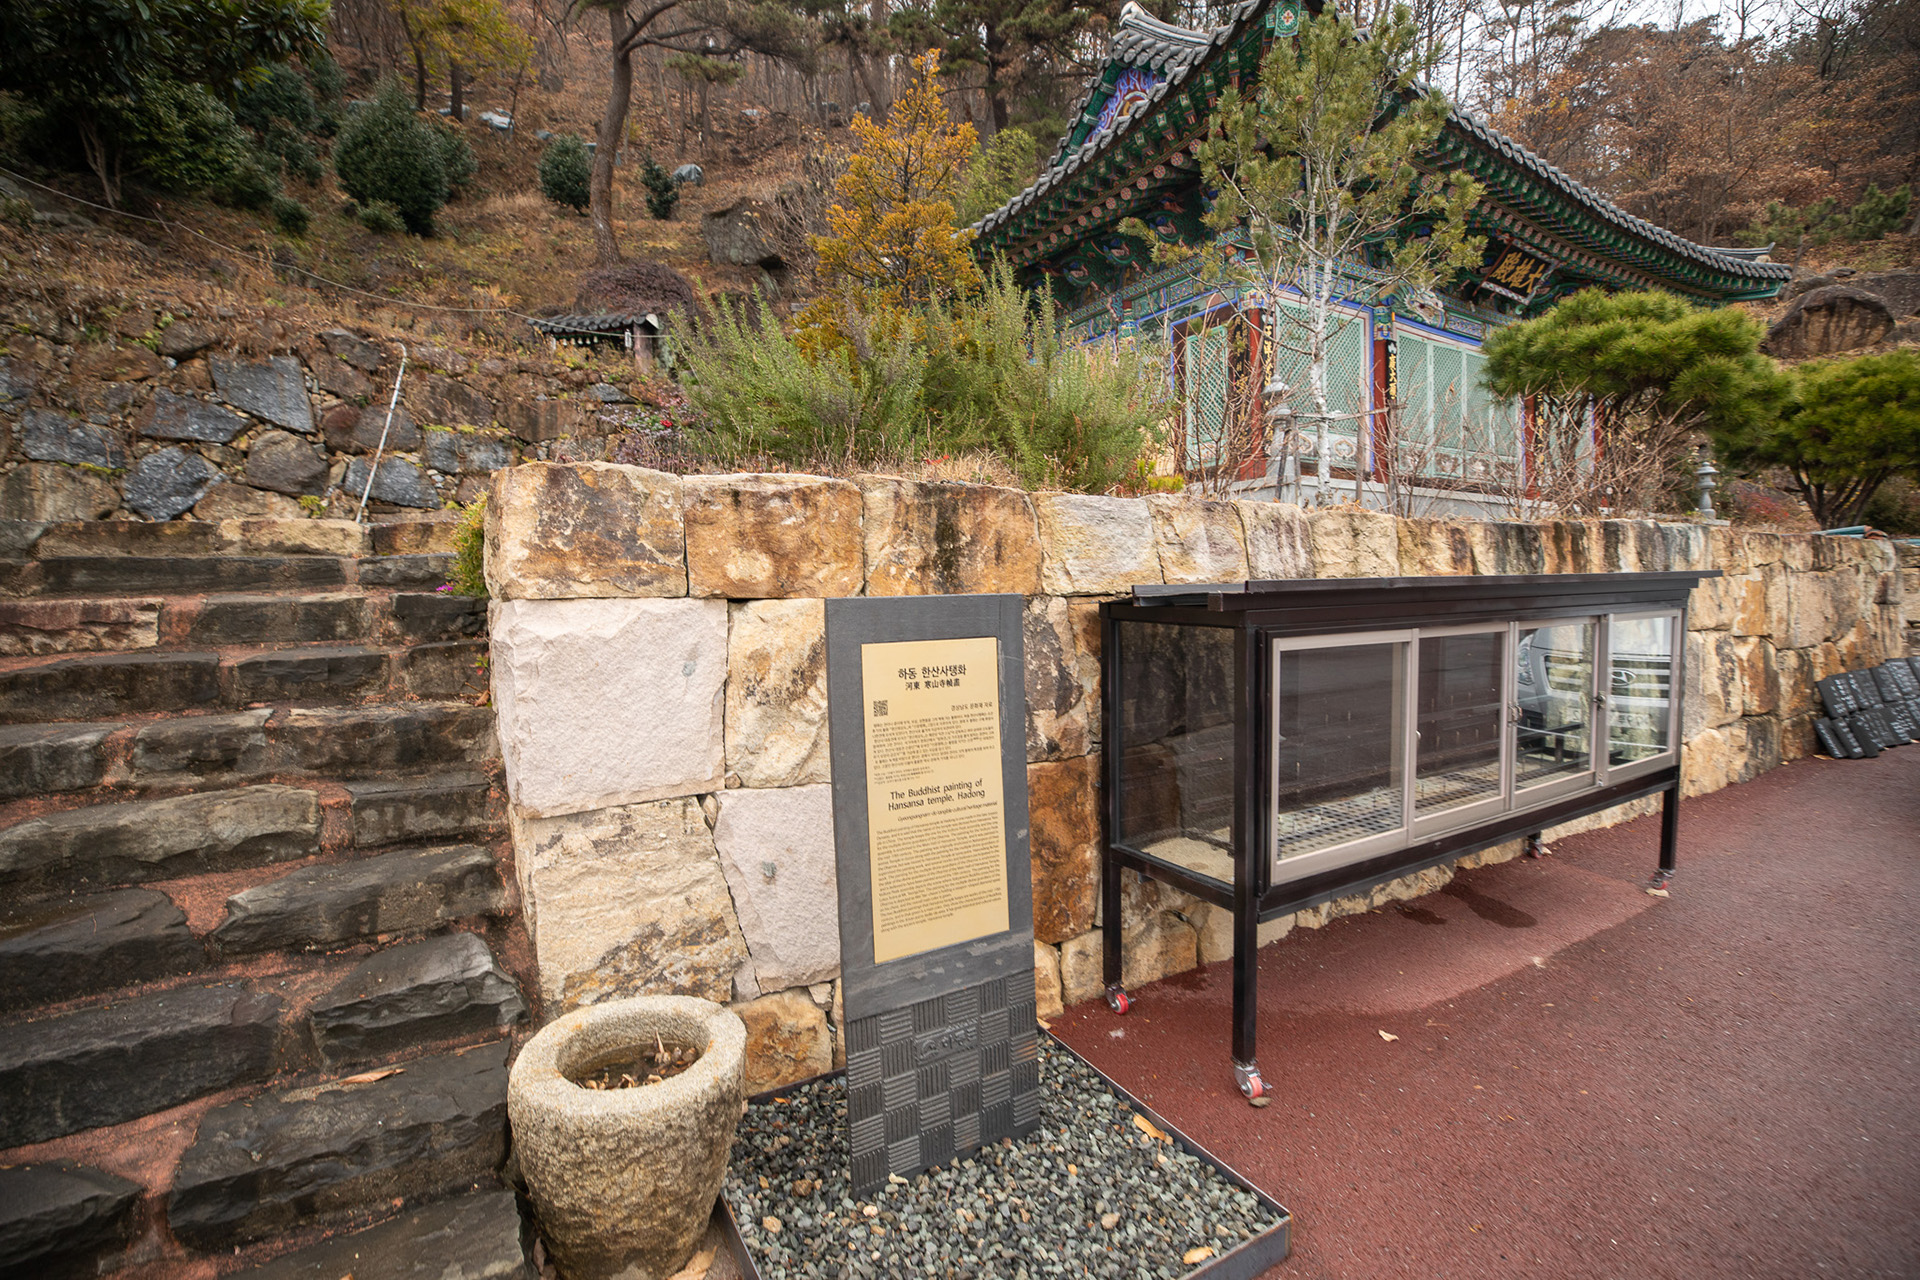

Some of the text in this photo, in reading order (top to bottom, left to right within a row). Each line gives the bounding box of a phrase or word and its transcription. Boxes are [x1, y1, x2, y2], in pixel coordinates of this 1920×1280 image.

[898, 664, 966, 680] 하동 한산사탱화
[888, 799, 925, 811] Hansansa
[957, 789, 985, 800] Hadong
[890, 778, 983, 800] The Buddhist painting of
